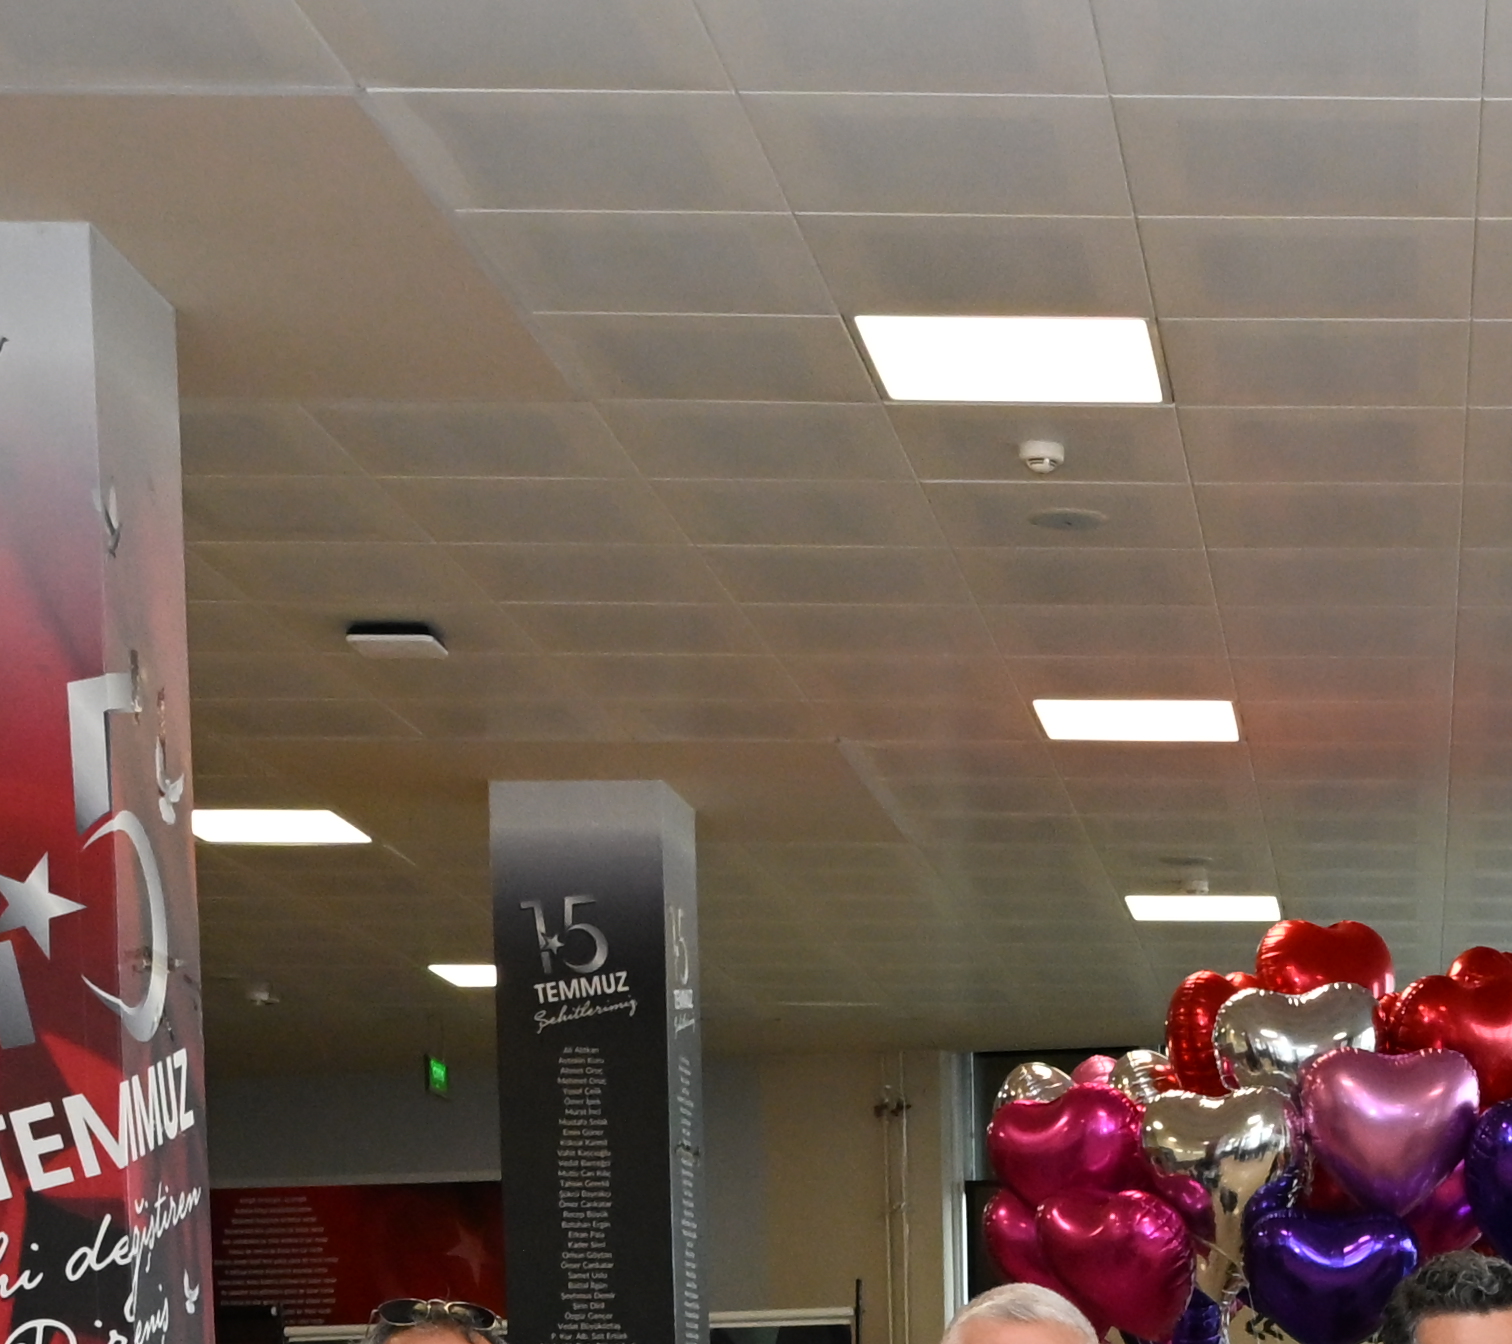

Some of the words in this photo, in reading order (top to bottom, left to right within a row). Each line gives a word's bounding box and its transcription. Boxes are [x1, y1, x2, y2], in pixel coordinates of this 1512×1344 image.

[519, 894, 609, 975] 15
[533, 994, 638, 1035] Şehitlerimiz
[534, 970, 630, 1005] TEMMUZ
[65, 1184, 202, 1325] değiştiren
